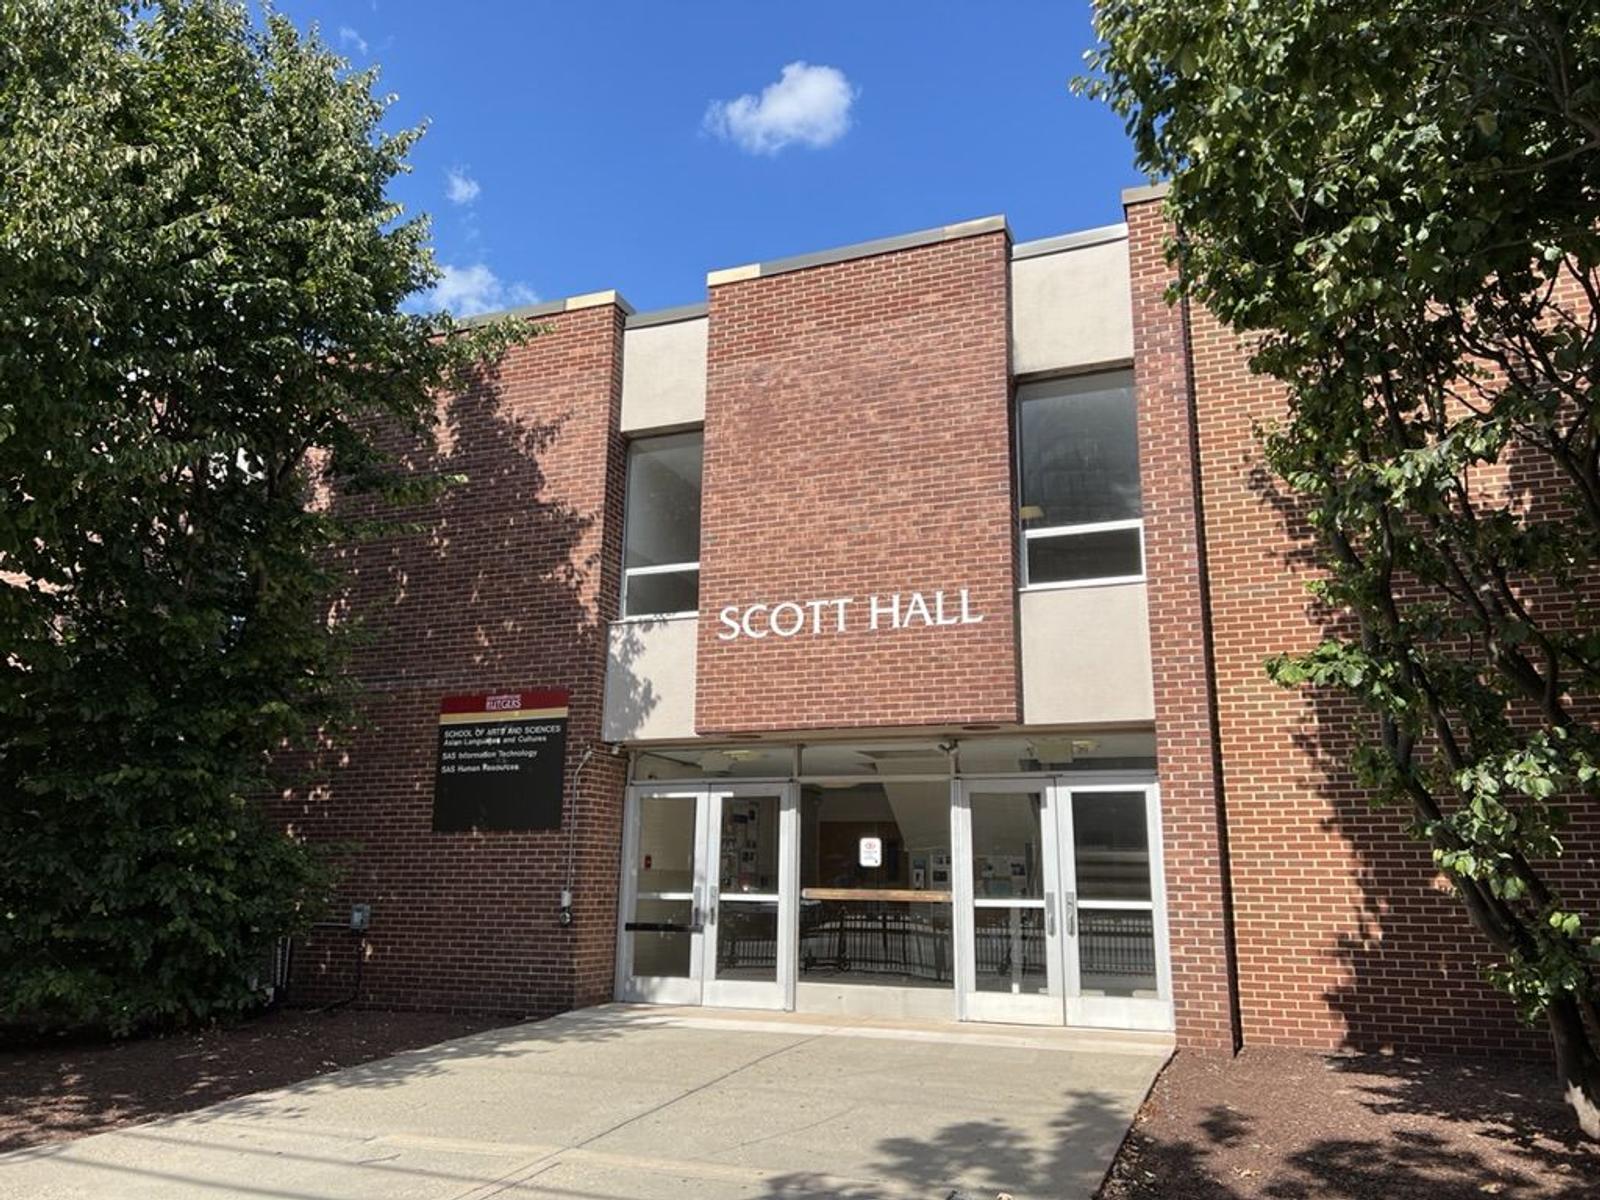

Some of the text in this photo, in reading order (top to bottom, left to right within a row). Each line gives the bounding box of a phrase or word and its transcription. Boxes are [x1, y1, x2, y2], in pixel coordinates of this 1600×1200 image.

[718, 588, 985, 641] SCOTT HALL
[444, 730, 473, 739] SCHOOL
[475, 728, 485, 737] OF
[508, 727, 523, 735] AND
[525, 725, 560, 734] SCIENCES
[442, 749, 537, 760] SAS Information Technology
[441, 765, 455, 773] SAS
